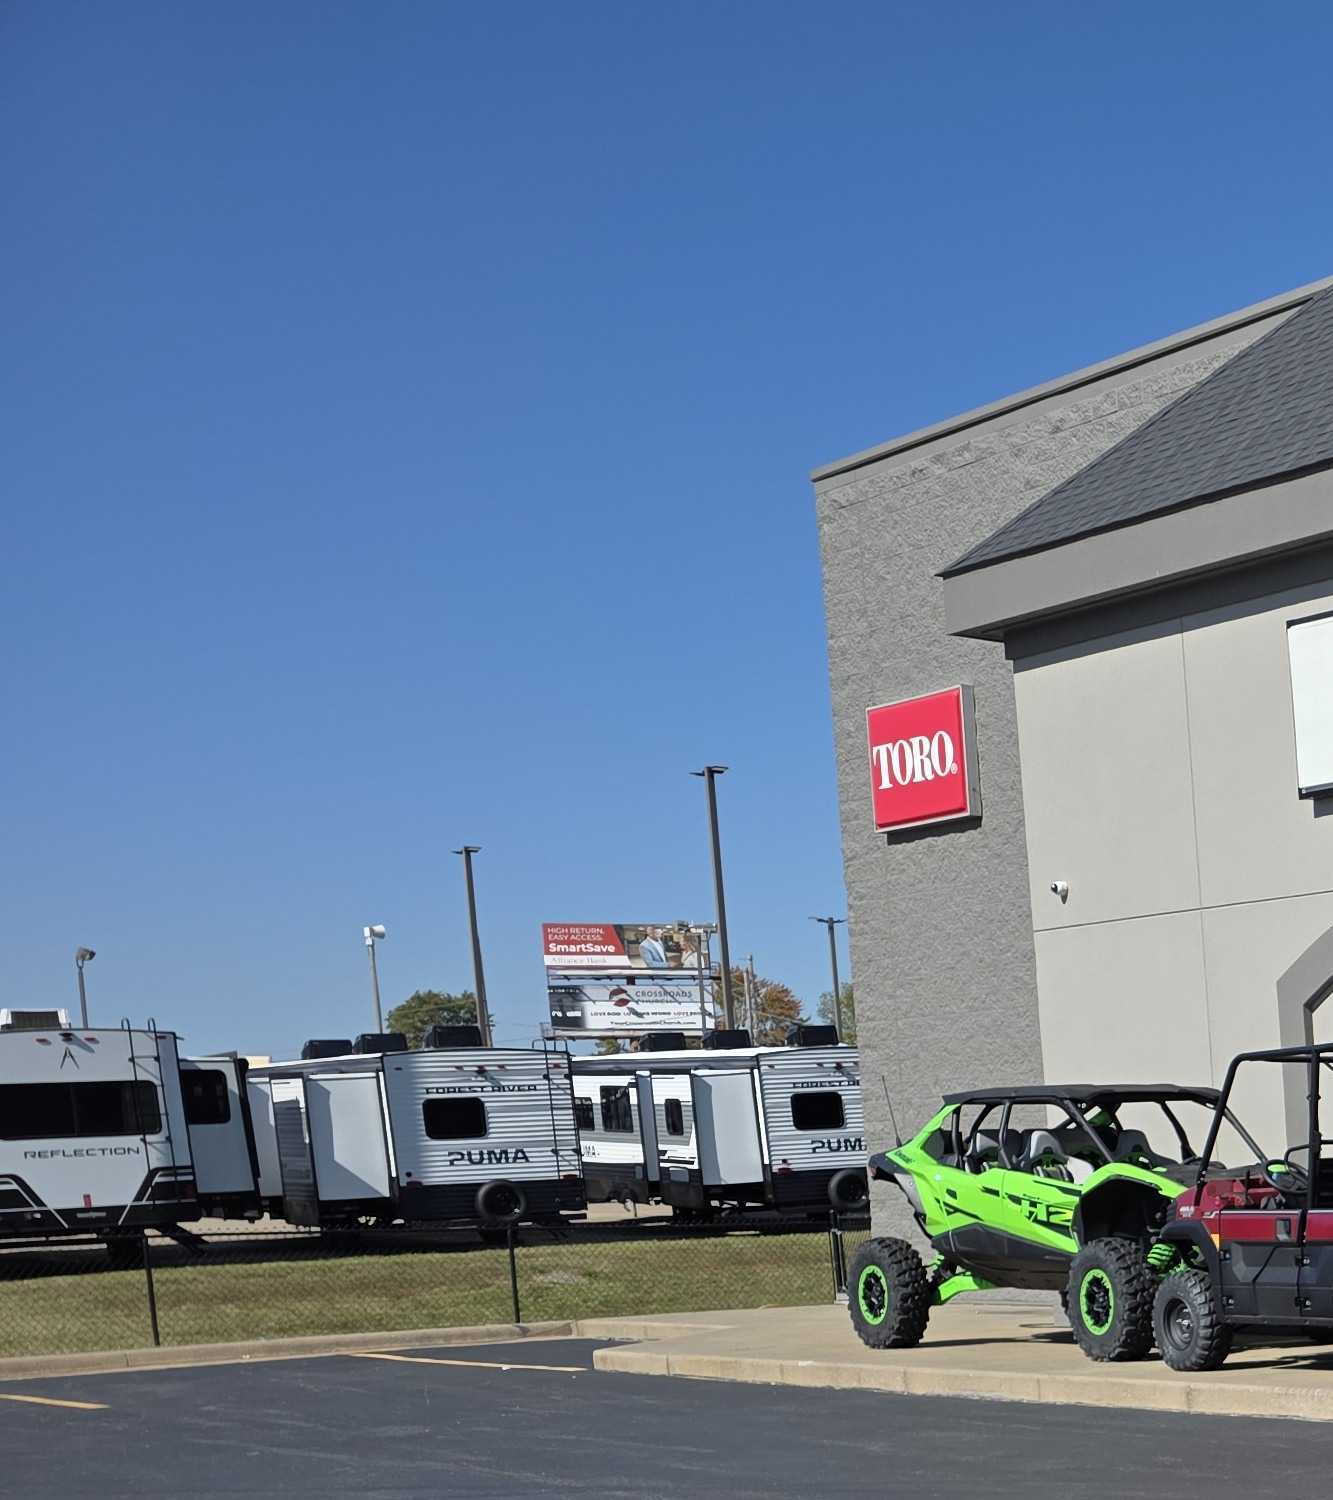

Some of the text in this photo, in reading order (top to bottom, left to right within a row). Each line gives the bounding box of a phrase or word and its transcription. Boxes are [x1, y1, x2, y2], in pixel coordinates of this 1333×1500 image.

[549, 943, 615, 952] SmartSave
[489, 1084, 537, 1092] RIVER
[810, 1137, 867, 1154] PUM
[23, 1146, 140, 1160] REFLECTION
[447, 1148, 531, 1167] PUMA
